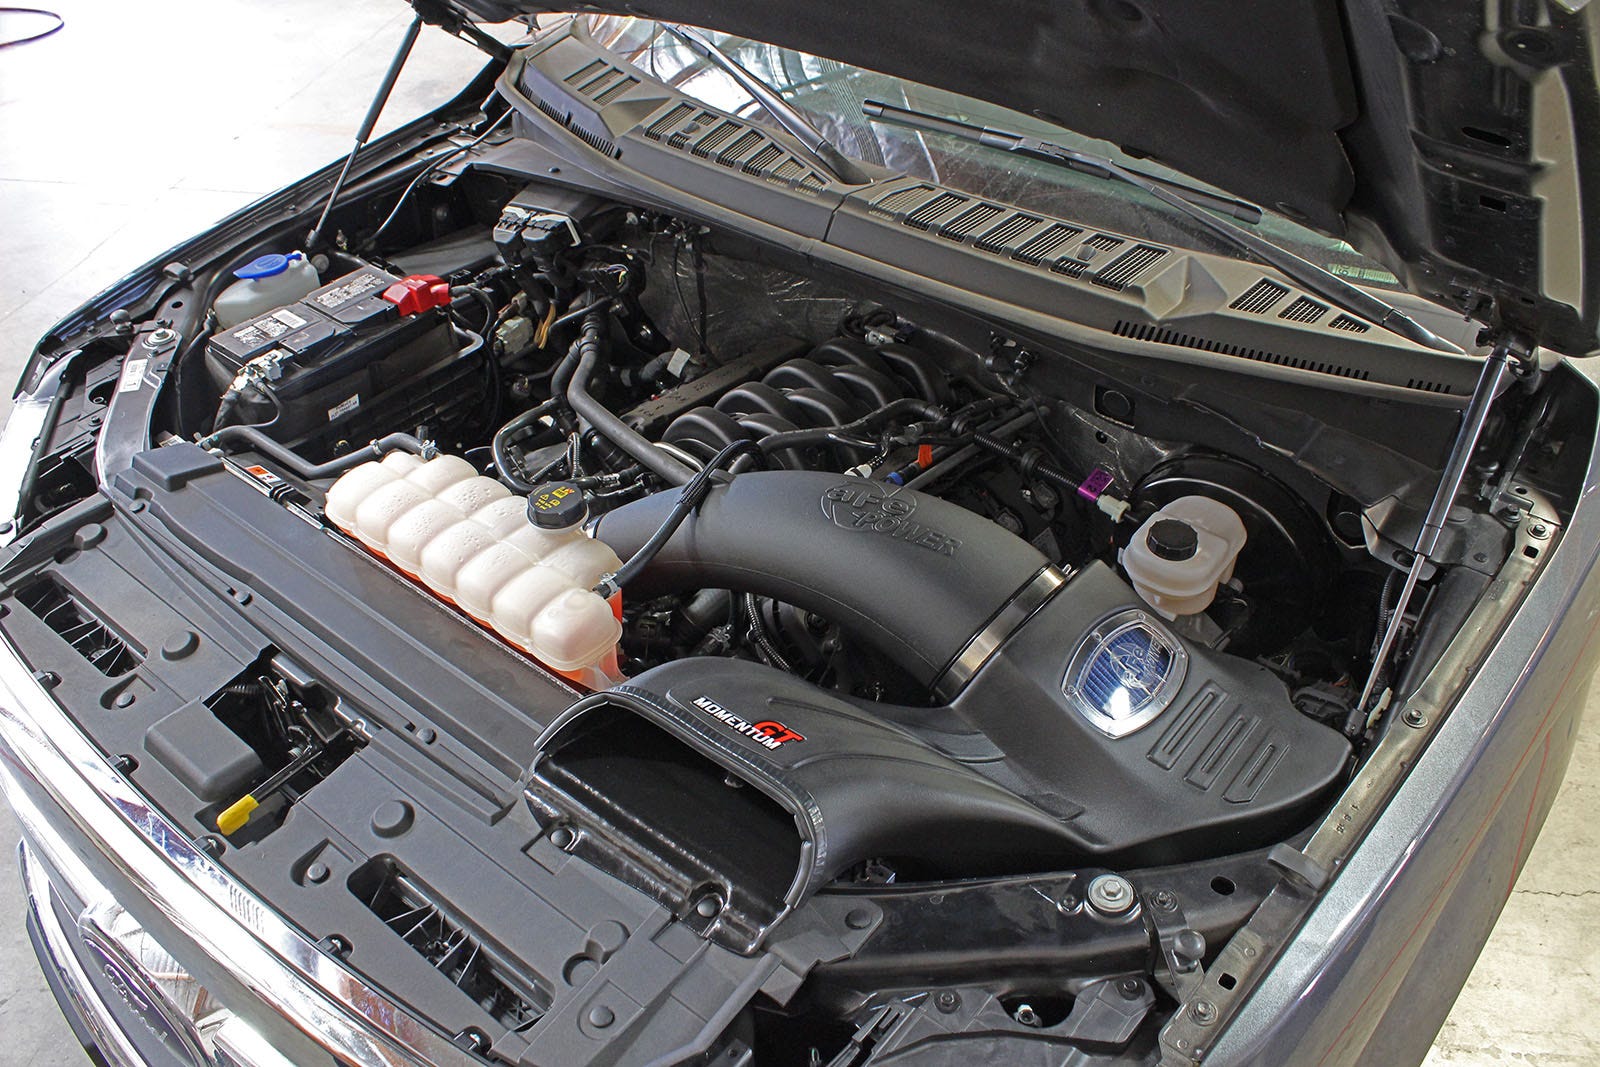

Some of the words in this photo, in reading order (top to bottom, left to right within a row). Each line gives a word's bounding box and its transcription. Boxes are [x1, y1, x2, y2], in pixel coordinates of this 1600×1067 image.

[852, 511, 963, 556] POWER
[693, 697, 782, 751] MOMENTUM
[753, 721, 804, 744] GT
